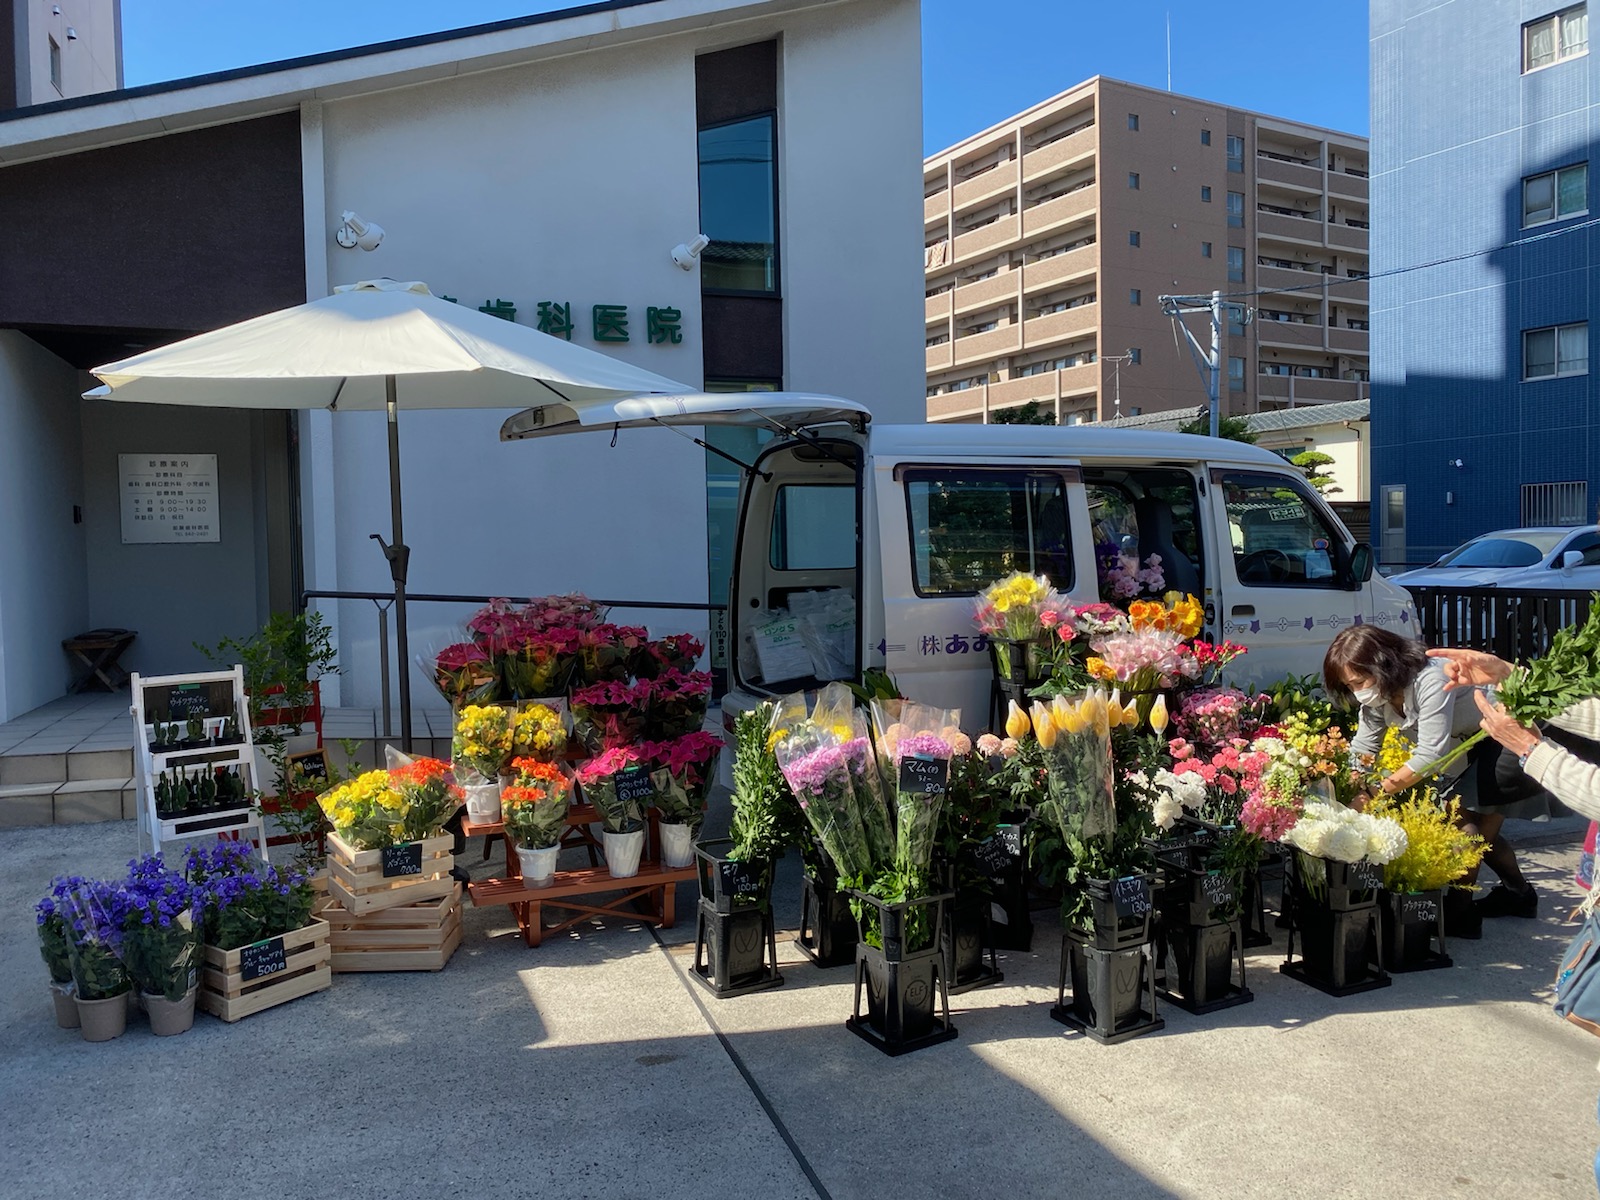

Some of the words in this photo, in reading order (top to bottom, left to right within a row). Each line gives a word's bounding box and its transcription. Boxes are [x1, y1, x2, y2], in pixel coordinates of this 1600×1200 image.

[440, 295, 682, 344] 科医院
[257, 961, 285, 977] 500円
[910, 985, 924, 997] ELF
